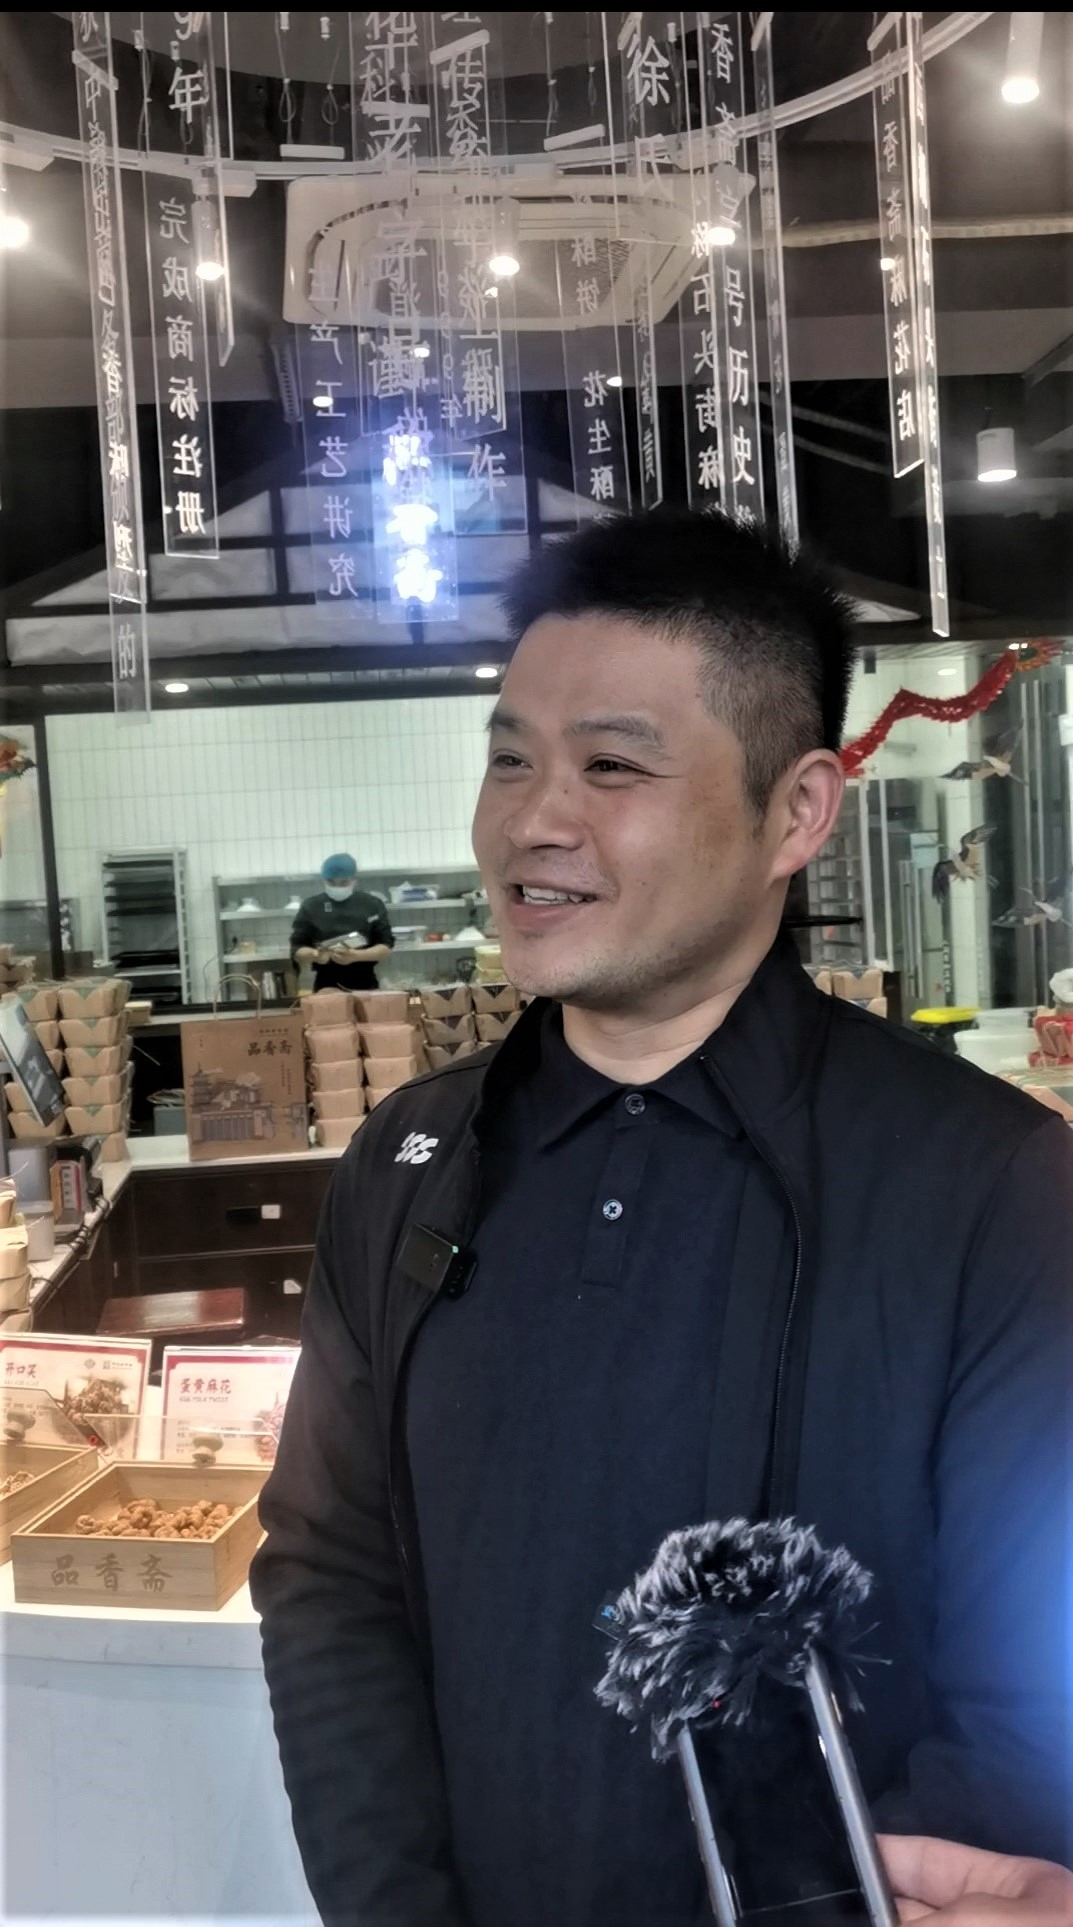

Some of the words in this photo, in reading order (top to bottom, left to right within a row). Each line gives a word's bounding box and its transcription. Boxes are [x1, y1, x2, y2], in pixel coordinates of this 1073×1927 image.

[180, 1377, 232, 1395] 蛋黄麻花
[50, 1552, 173, 1593] 品香斋
